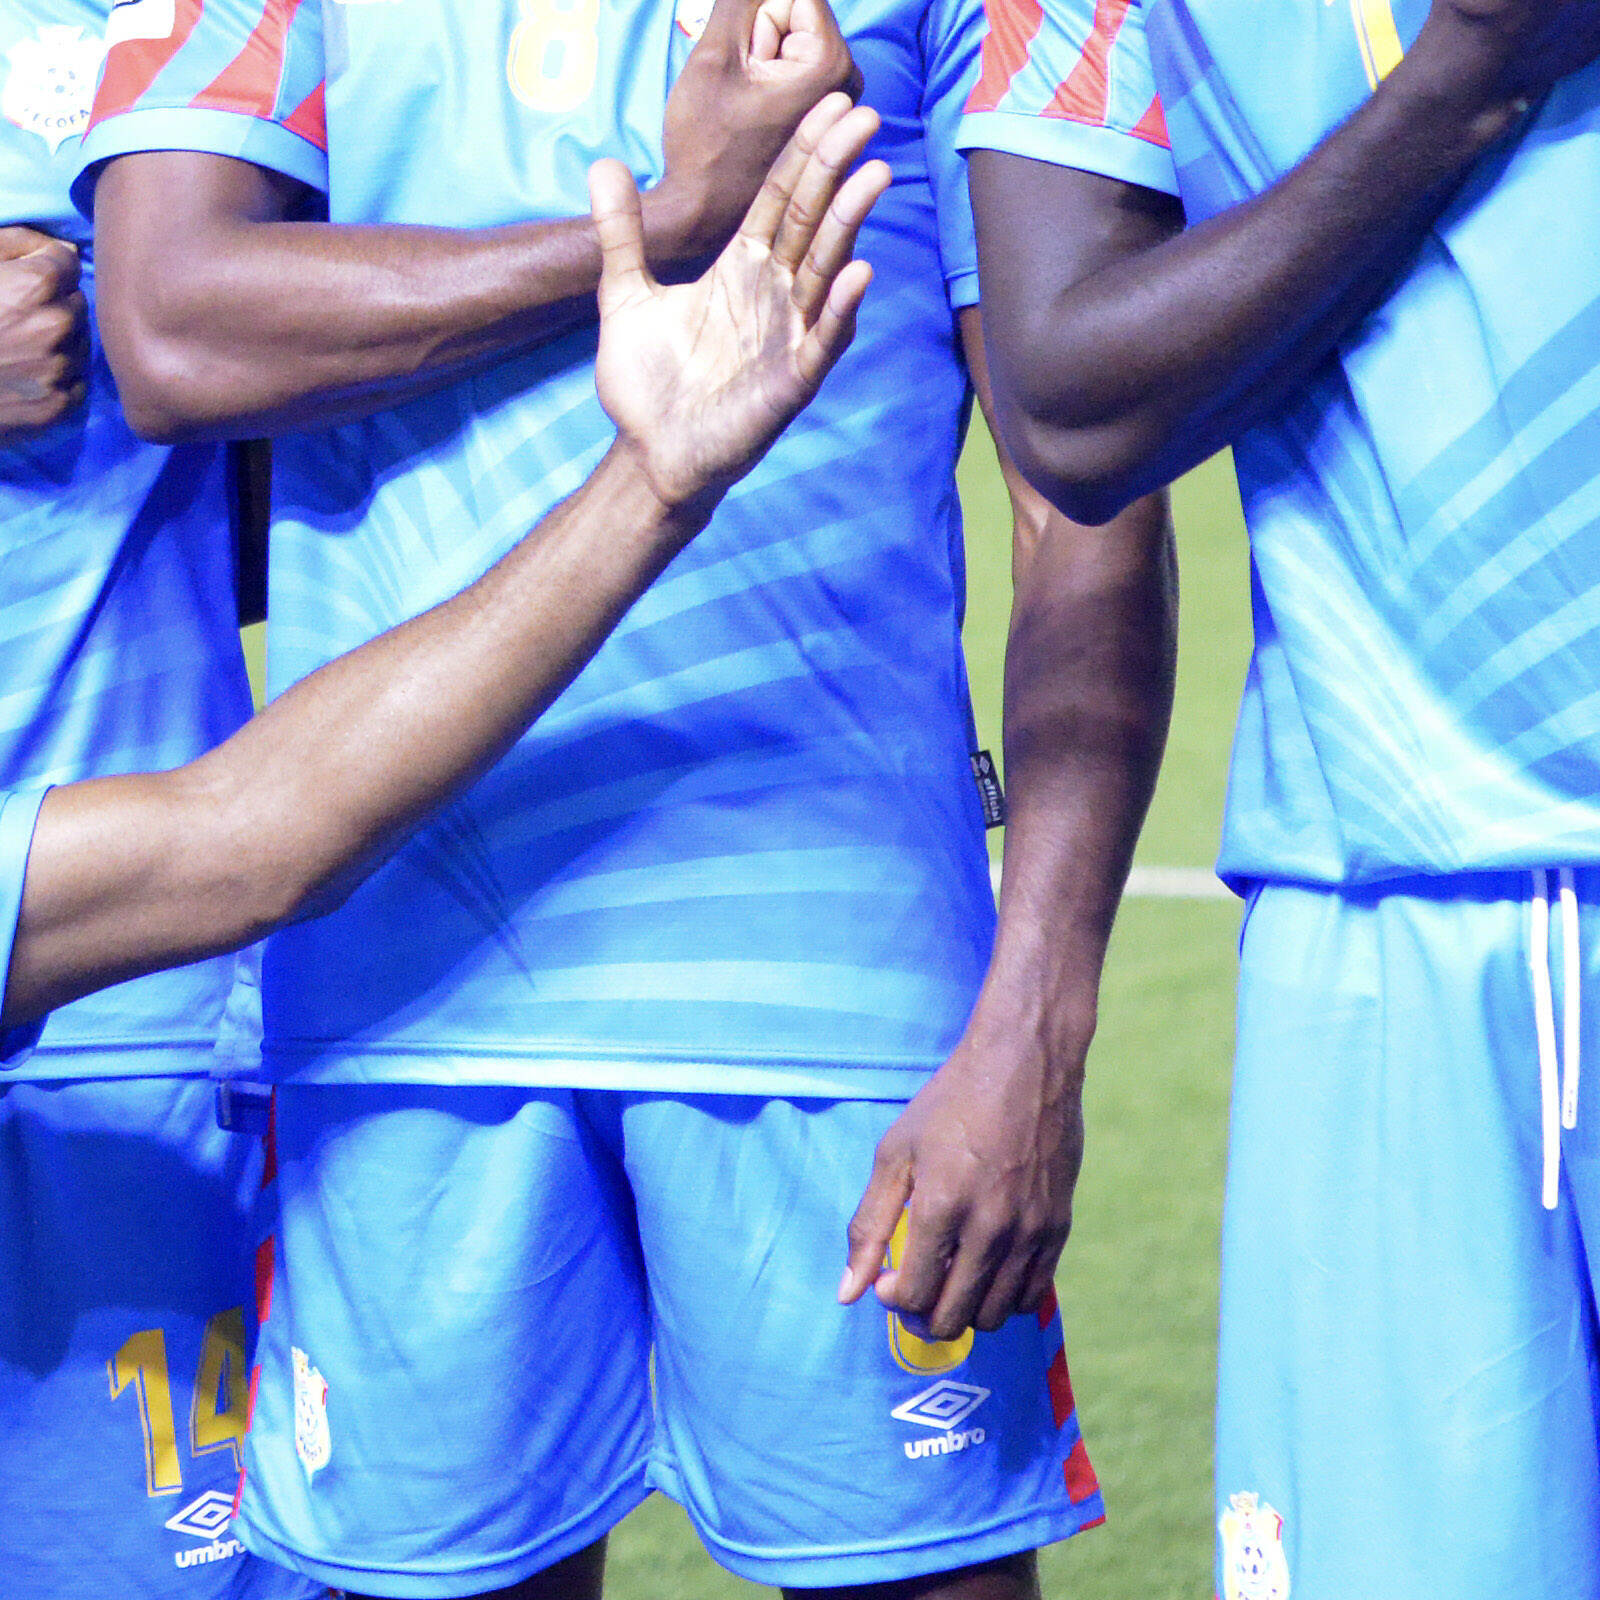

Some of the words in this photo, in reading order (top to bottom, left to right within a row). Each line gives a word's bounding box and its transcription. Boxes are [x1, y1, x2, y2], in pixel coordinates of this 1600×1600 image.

[107, 1305, 248, 1498] 14
[904, 1425, 986, 1460] umbro
[174, 1538, 246, 1569] umbr
